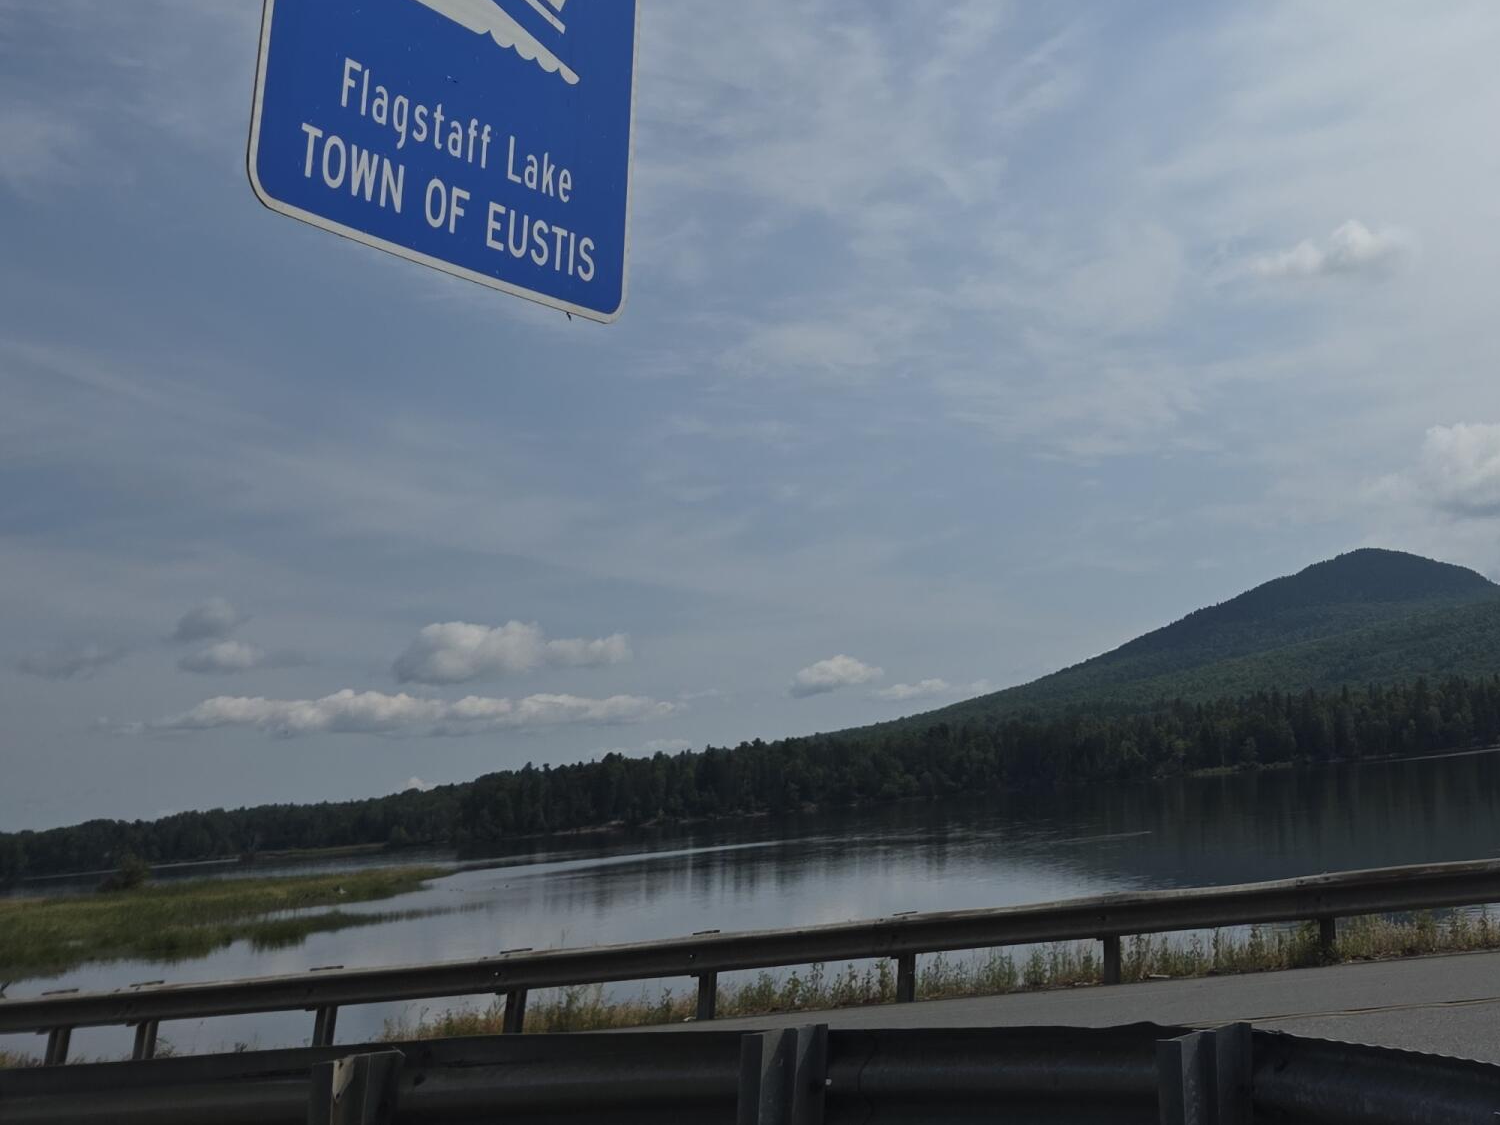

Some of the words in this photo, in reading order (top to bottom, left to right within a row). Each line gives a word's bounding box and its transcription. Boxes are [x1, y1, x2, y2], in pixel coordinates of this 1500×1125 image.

[302, 123, 405, 213] TOWN
[425, 178, 470, 234] OF
[486, 201, 595, 282] EUSTIS
[341, 57, 491, 169] Flagstaff
[507, 136, 572, 202] Lake
